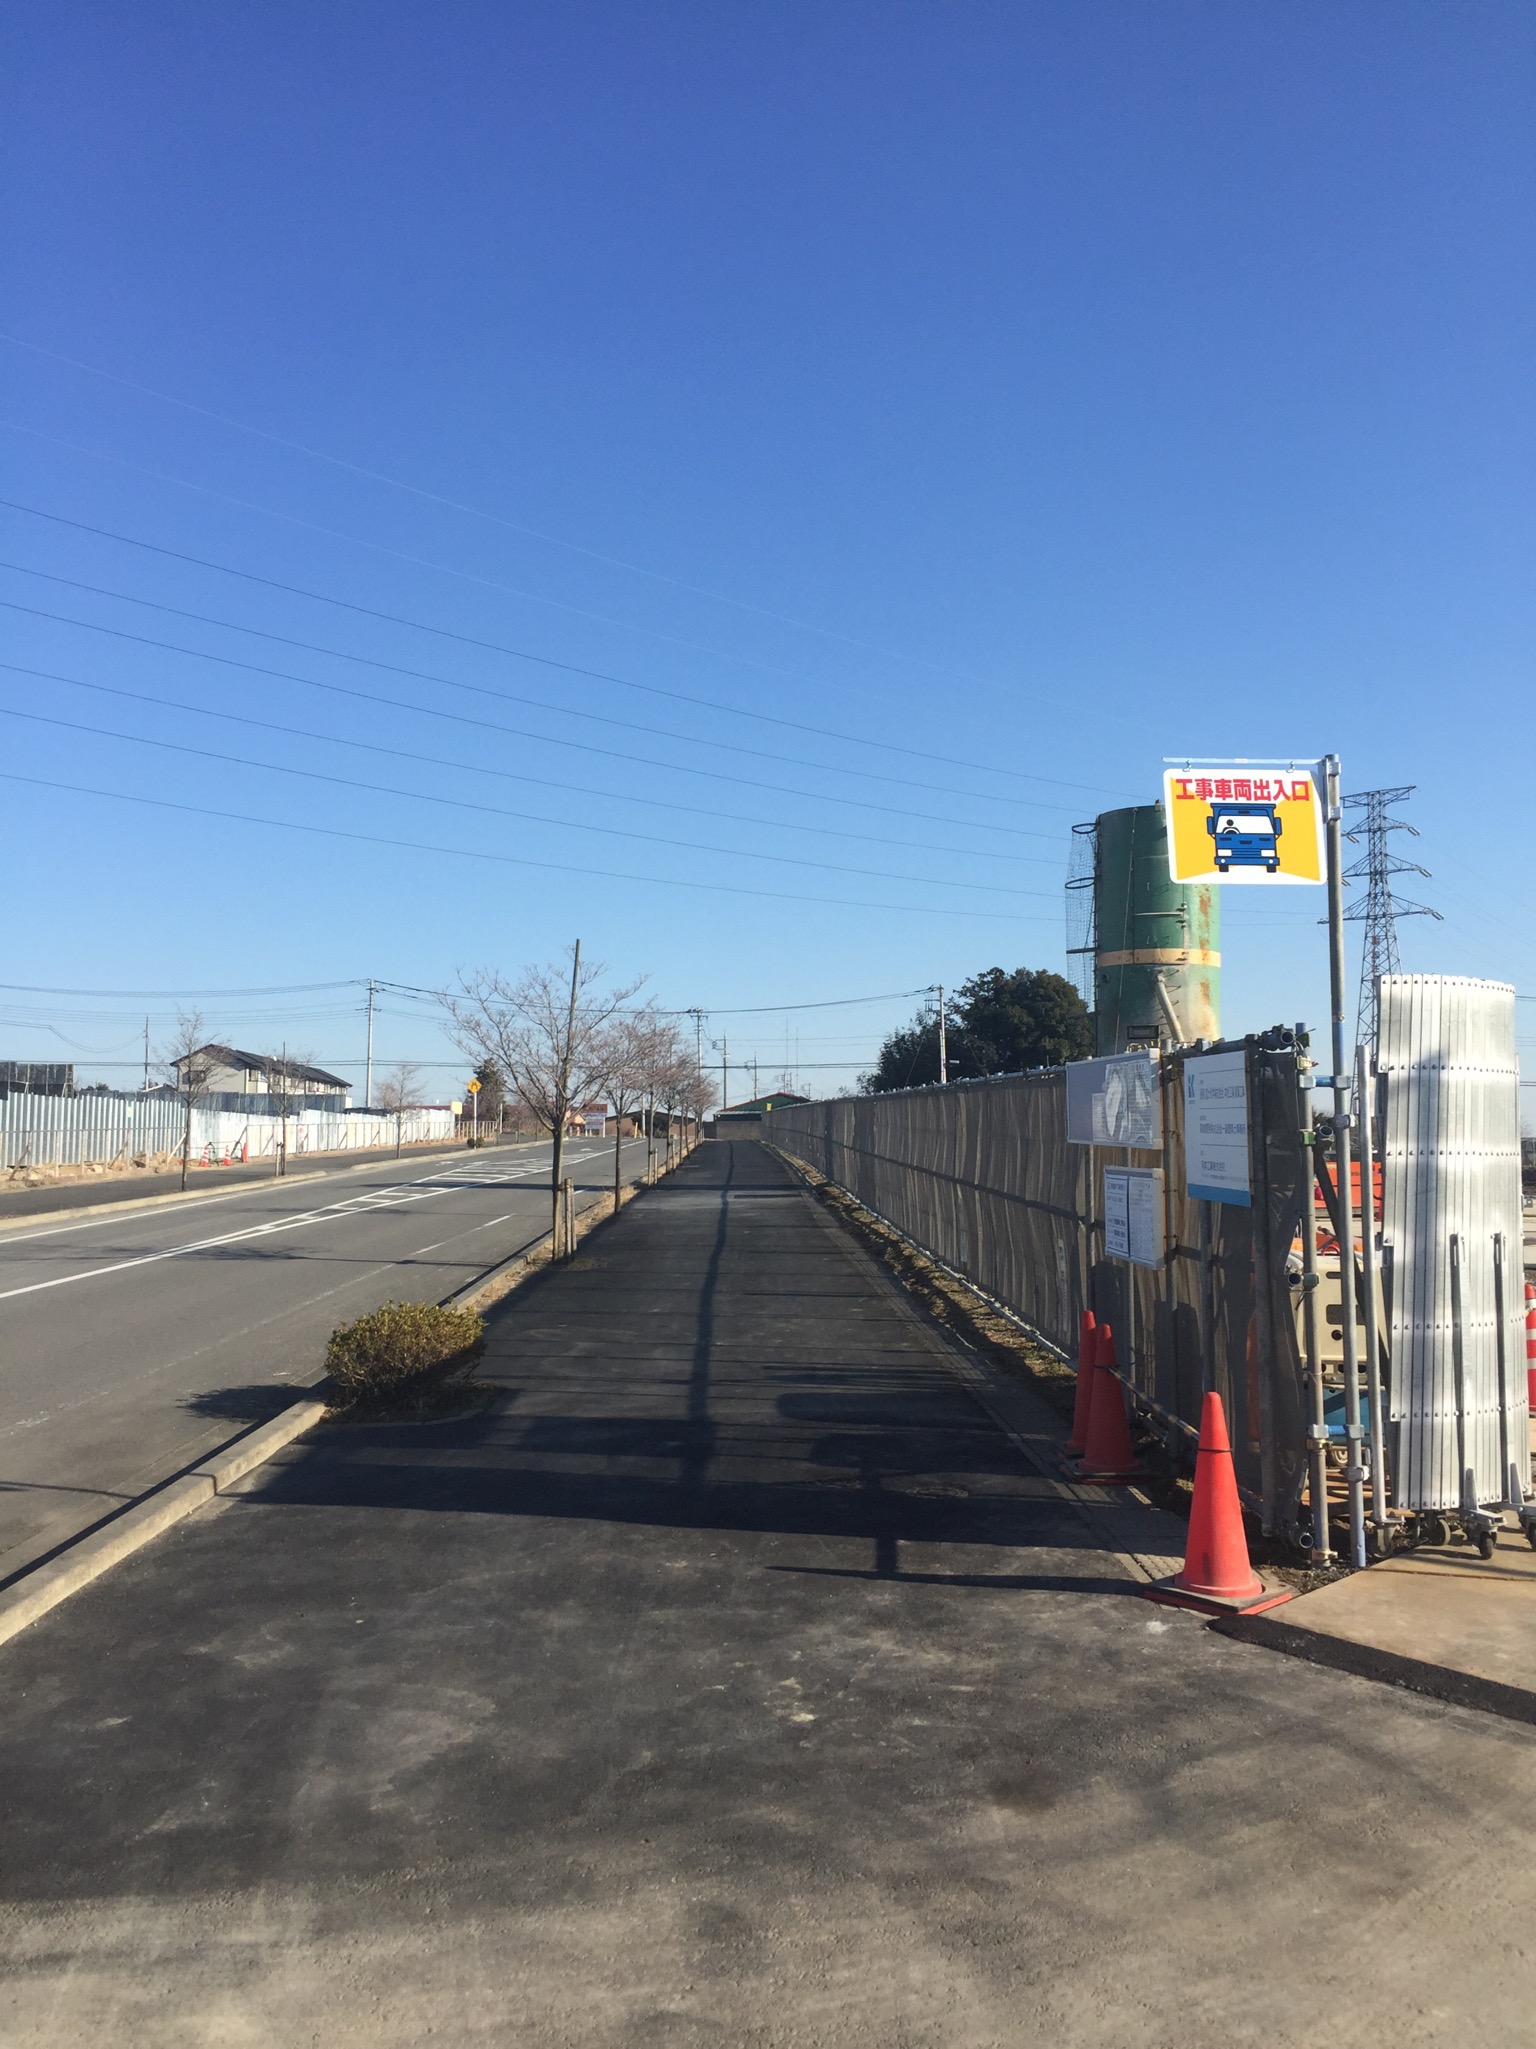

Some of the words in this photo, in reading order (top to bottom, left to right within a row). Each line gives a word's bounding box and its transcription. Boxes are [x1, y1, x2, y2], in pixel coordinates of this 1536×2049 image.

[1175, 778, 1309, 801] 工事車両出入口
